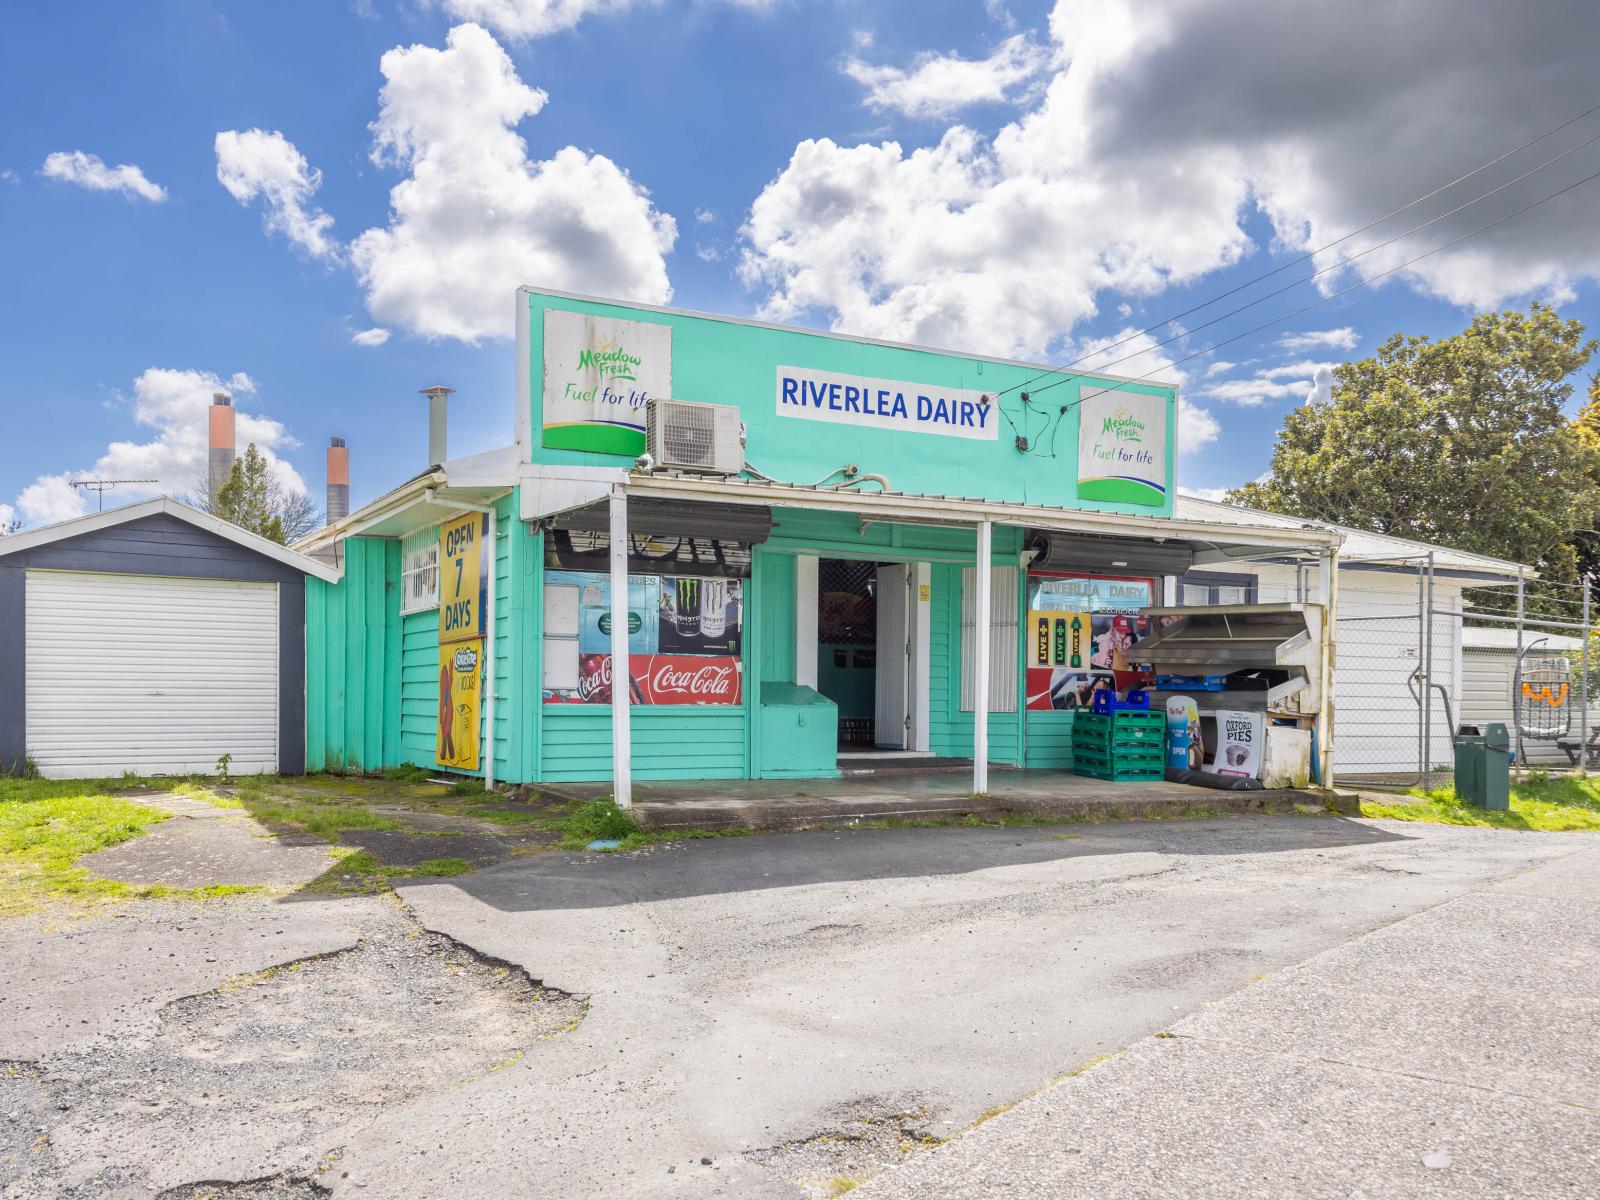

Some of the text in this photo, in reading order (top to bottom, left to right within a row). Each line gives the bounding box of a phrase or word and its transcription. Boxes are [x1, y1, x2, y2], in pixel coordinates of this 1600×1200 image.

[576, 347, 641, 371] Meadow
[599, 362, 632, 381] Fresh
[564, 383, 598, 401] Fuel
[601, 387, 624, 405] for
[781, 377, 991, 429] RIVERLEA DAIRY
[1100, 415, 1145, 435] Meadow
[1116, 427, 1138, 440] Fresh
[1093, 444, 1153, 465] Fuel for life
[446, 521, 475, 558] OPEN
[455, 558, 464, 597] 7
[445, 599, 471, 631] DAYS
[653, 664, 733, 694] Coca-Cola
[1226, 720, 1252, 731] OXFORD
[1227, 730, 1252, 742] PIES
